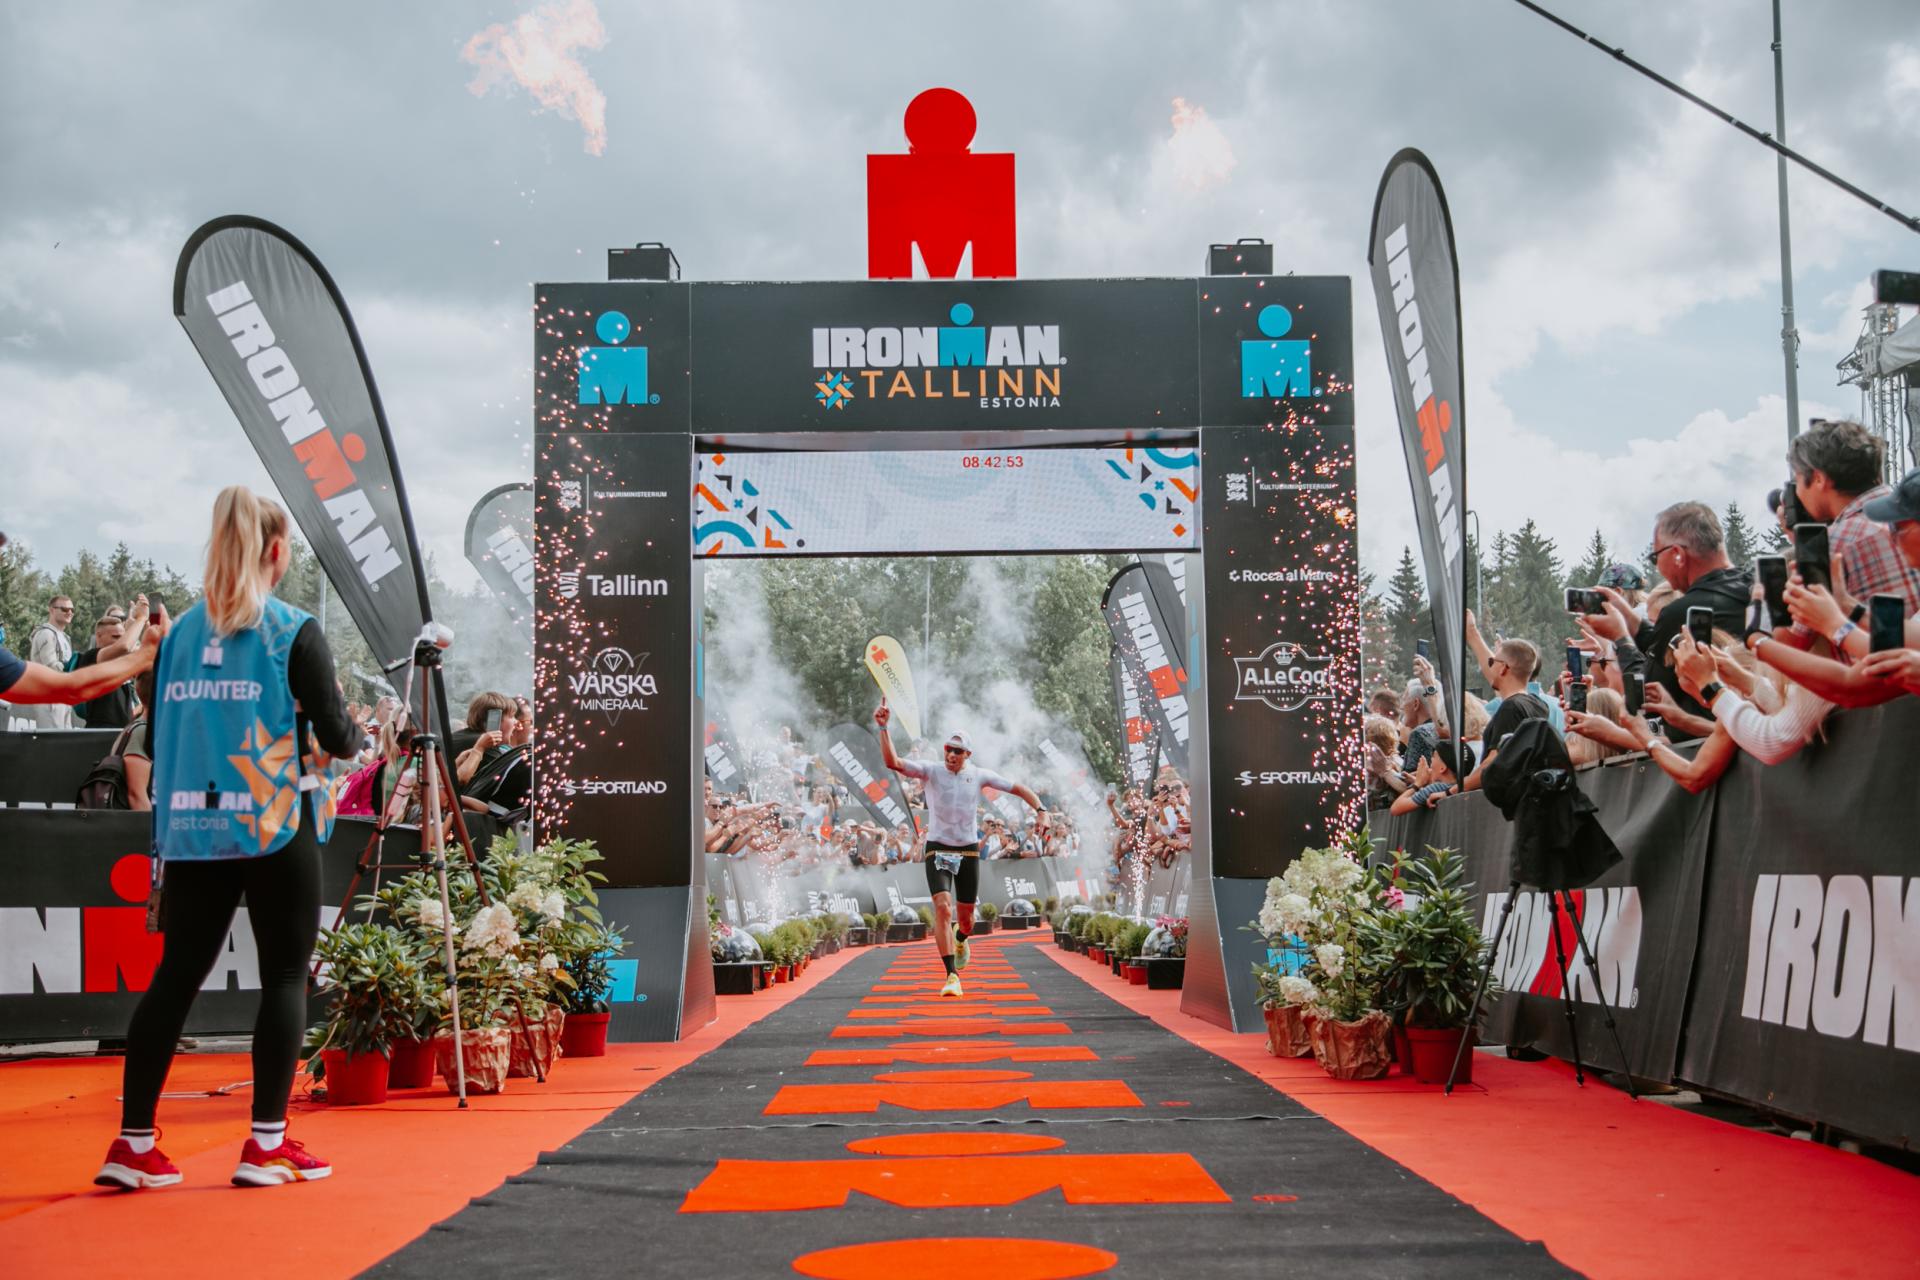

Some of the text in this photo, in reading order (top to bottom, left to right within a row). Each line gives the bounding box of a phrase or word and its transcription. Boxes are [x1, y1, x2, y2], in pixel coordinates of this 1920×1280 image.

[812, 303, 1060, 367] IRONMAN
[860, 368, 1061, 398] TALLINN
[979, 397, 1061, 408] ESTONIA
[1385, 223, 1460, 569] IRONMAN
[206, 280, 403, 584] IRONMAN
[962, 456, 1024, 468] 08:42:53
[586, 574, 668, 596] Tallinn
[1242, 569, 1334, 581] Rocca al Mare
[568, 672, 658, 697] VÄRSKA
[580, 698, 648, 711] MINERAAL
[584, 780, 667, 794] SPORTLAND
[829, 740, 907, 827] IRONMAN
[1260, 772, 1341, 784] SPORTLAND
[171, 813, 229, 830] estonia
[1741, 874, 1920, 1053] IRON
